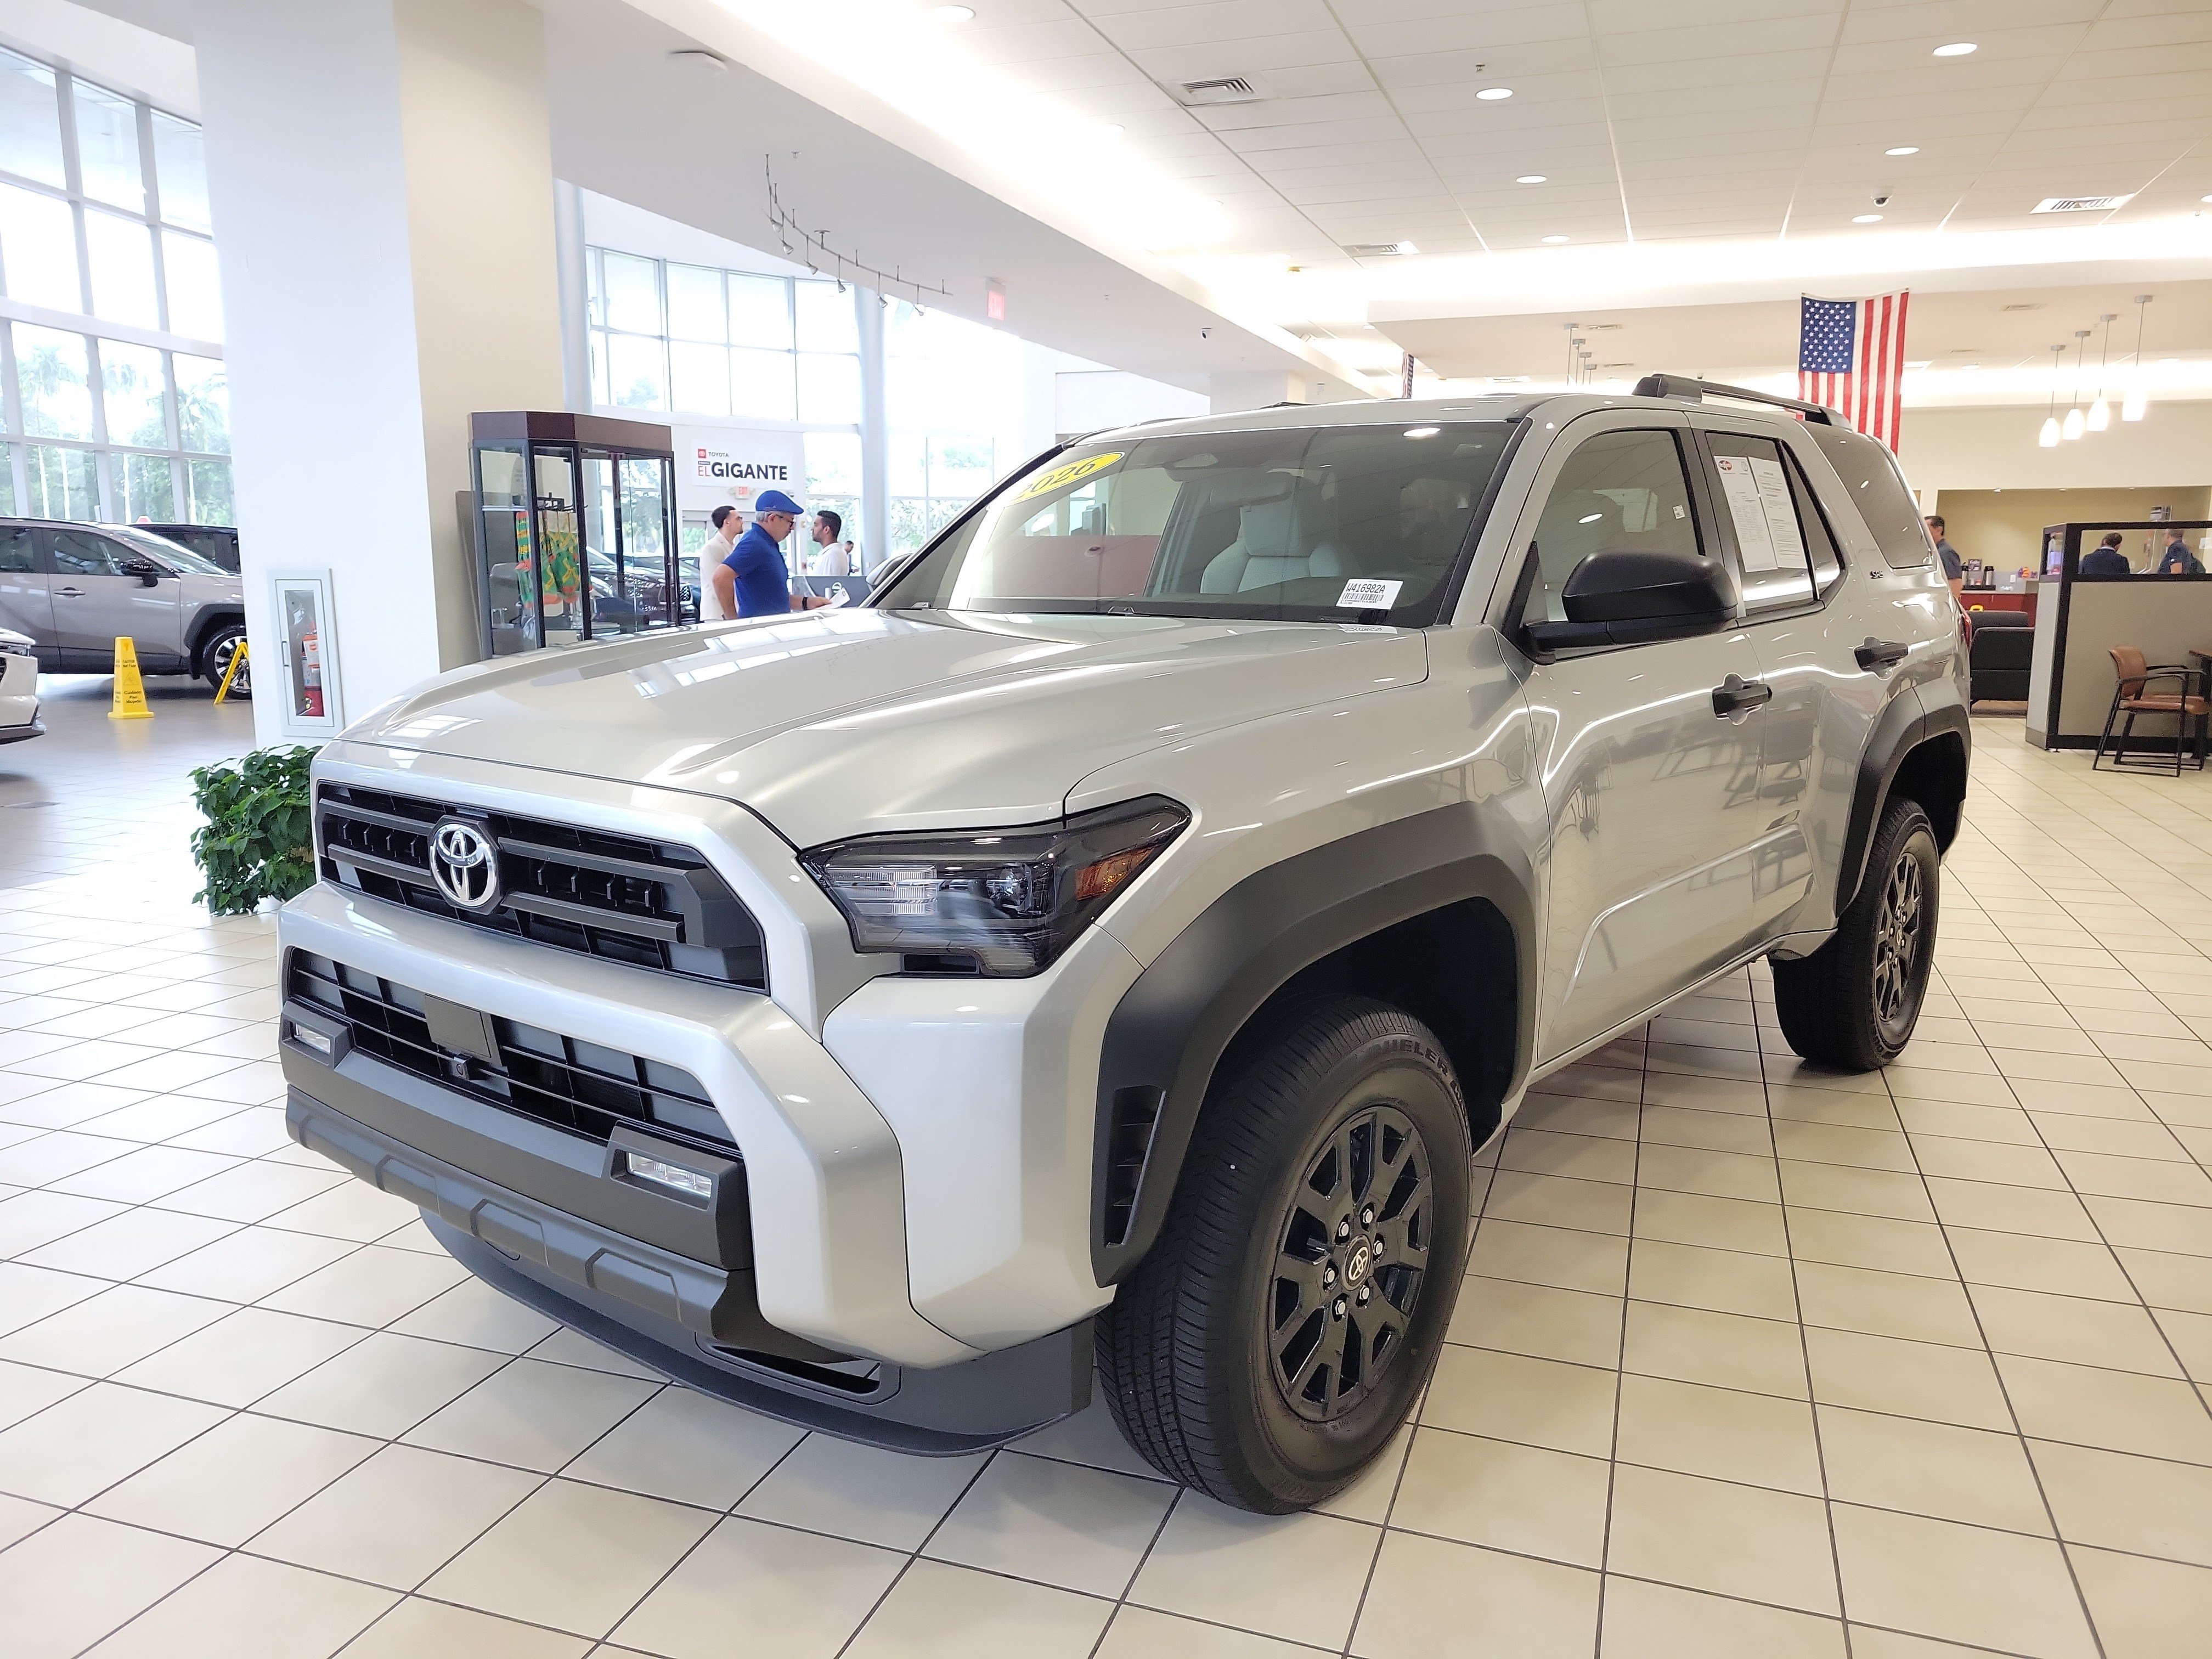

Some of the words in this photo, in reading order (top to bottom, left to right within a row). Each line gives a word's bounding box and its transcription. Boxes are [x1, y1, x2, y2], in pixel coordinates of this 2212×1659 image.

[698, 466, 711, 477] EL
[711, 461, 787, 481] GIGANTE
[1012, 456, 1103, 500] 2026
[1346, 583, 1386, 594] W416982A
